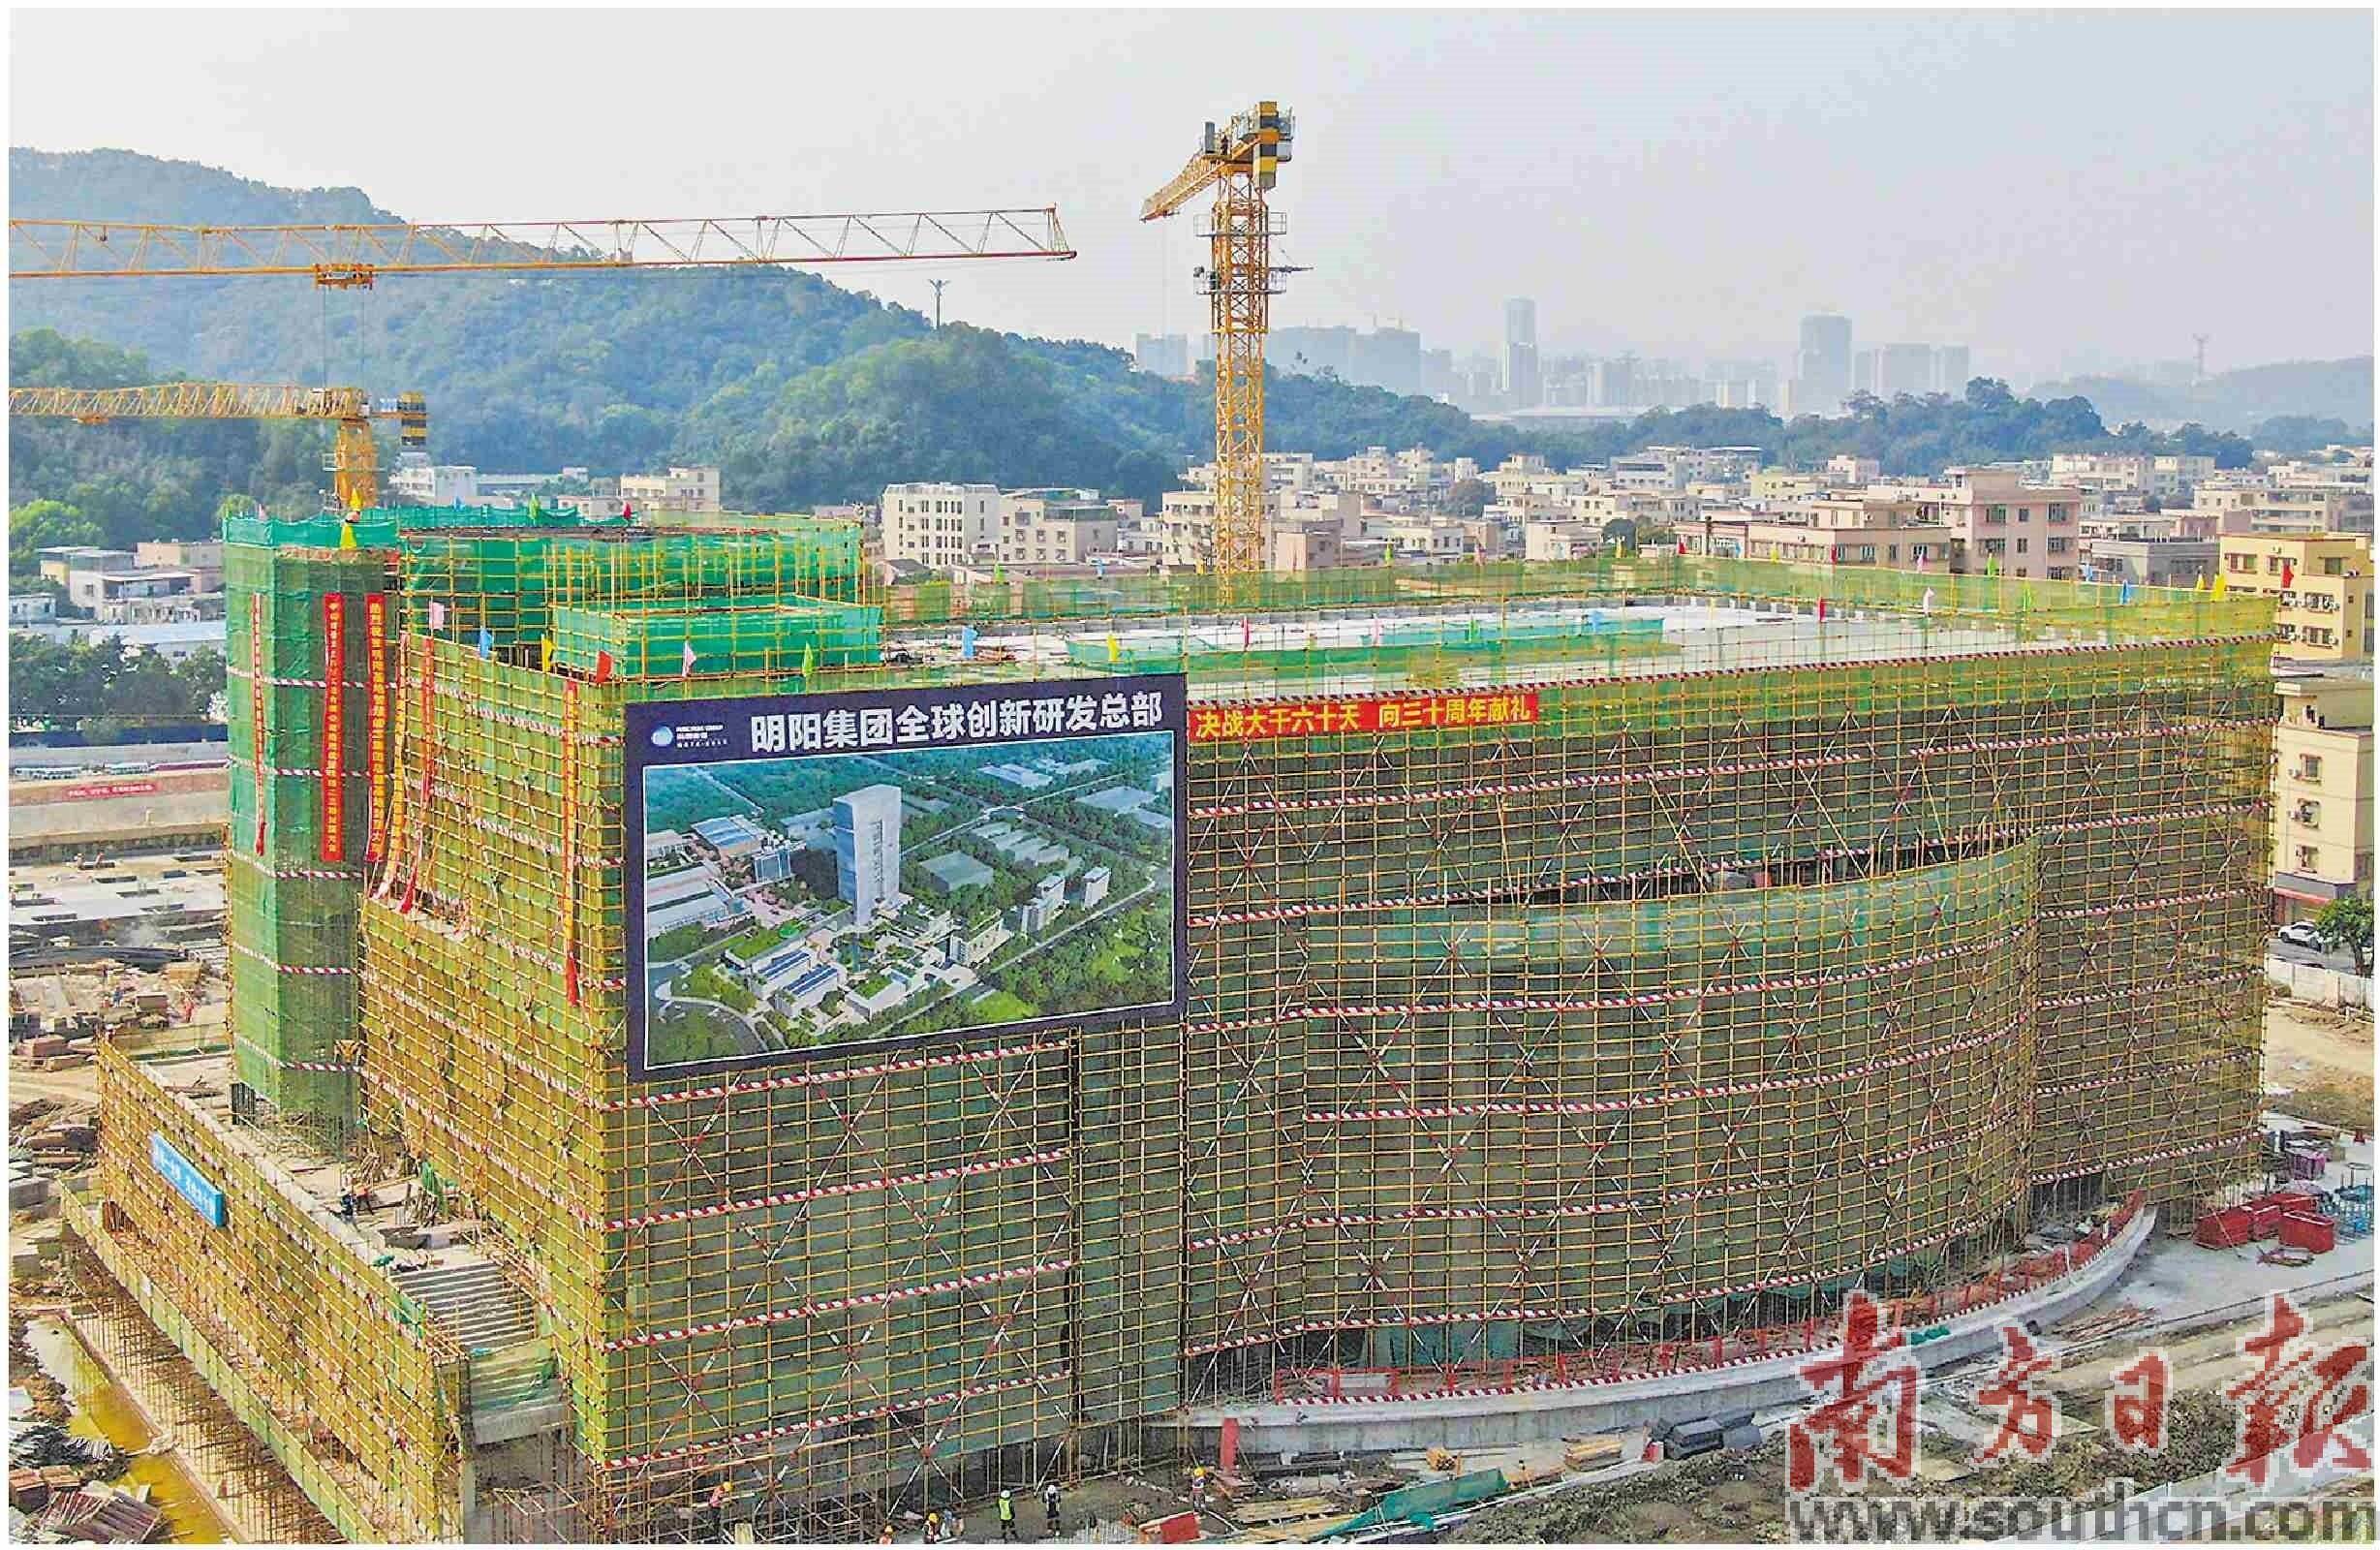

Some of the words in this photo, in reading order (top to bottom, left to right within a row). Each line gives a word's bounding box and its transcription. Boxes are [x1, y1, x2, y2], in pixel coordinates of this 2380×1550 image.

[751, 691, 1163, 753] 明阳集团全球创新研发总部
[1378, 695, 1530, 728] 向三十周年献礼
